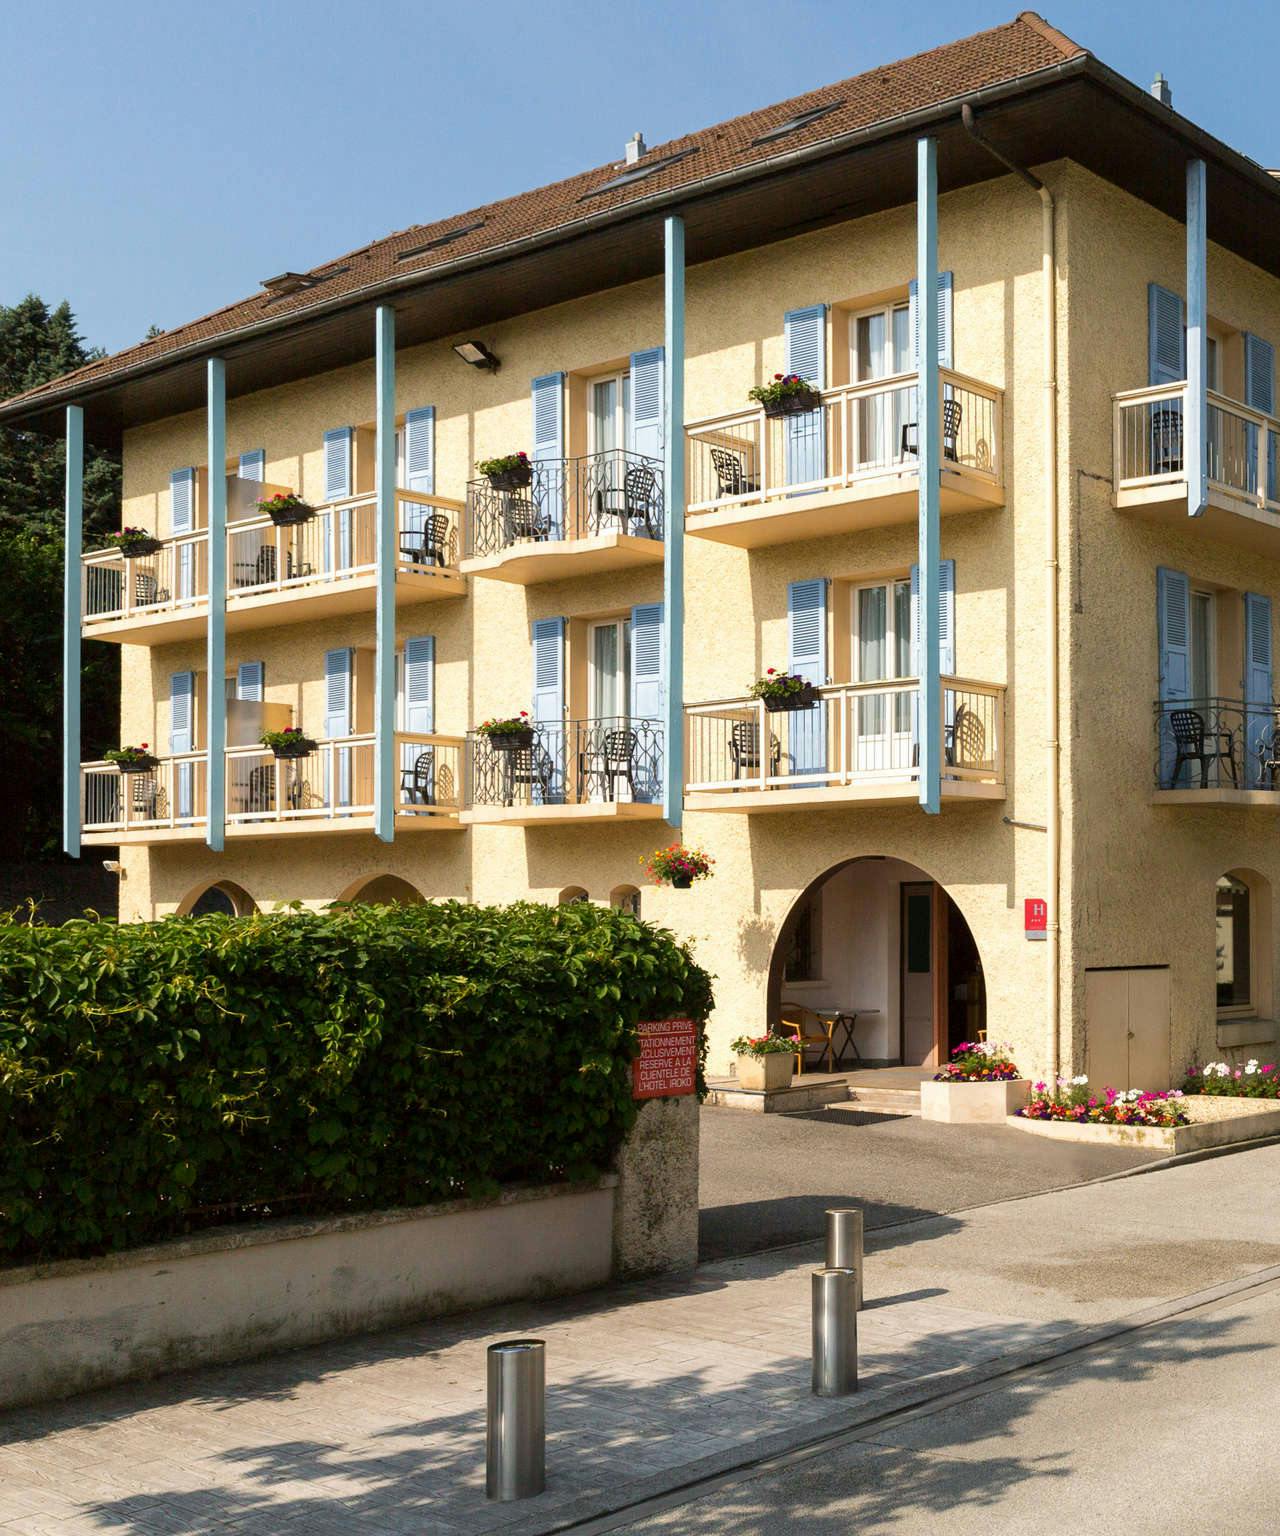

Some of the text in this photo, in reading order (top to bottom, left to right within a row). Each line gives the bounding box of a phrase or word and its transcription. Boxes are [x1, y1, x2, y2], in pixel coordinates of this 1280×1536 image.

[1033, 903, 1044, 916] H
[637, 1022, 671, 1032] PARKING
[639, 1035, 696, 1048] TATIONNEMENT
[639, 1046, 696, 1058] XCLUSIVEMENT
[682, 1056, 691, 1066] LA
[680, 1067, 691, 1077] DE
